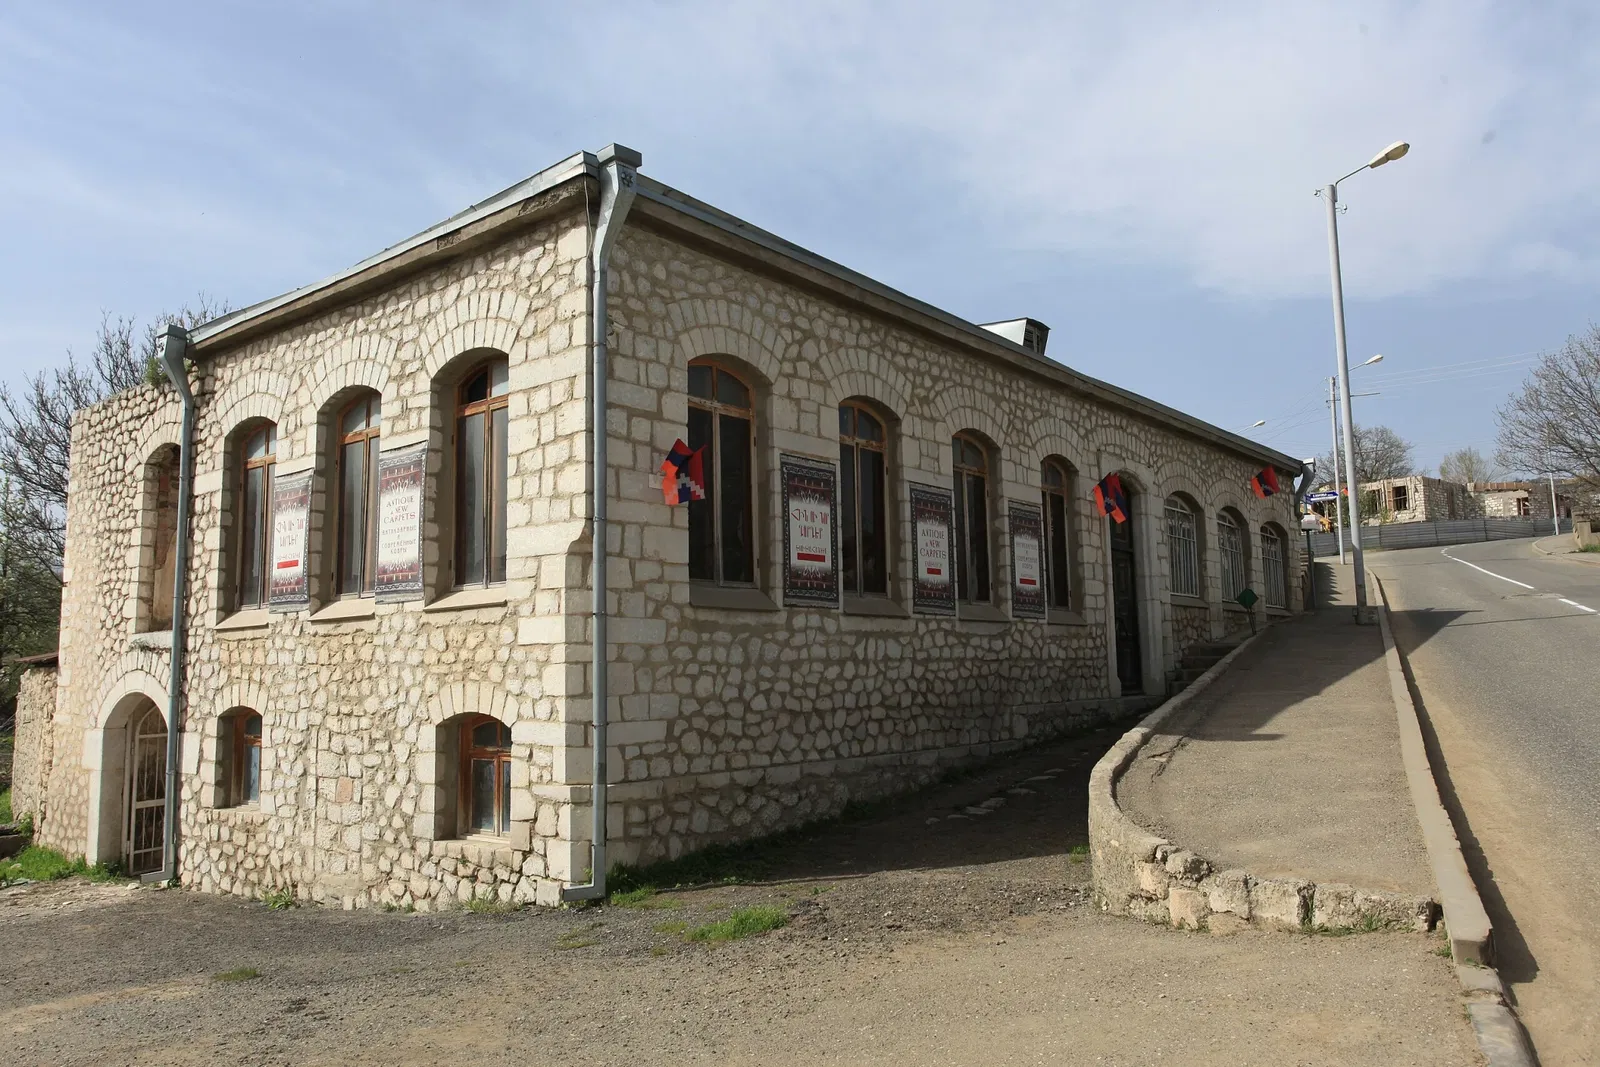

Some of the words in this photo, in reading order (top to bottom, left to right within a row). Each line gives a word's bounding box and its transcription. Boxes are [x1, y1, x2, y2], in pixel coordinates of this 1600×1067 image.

[386, 495, 415, 507] ANTIQUE
[395, 504, 409, 513] NEW
[383, 511, 416, 524] CARPETS
[921, 528, 945, 540] ANTIQUE
[929, 539, 941, 548] NEW
[919, 547, 947, 560] CARPETS
